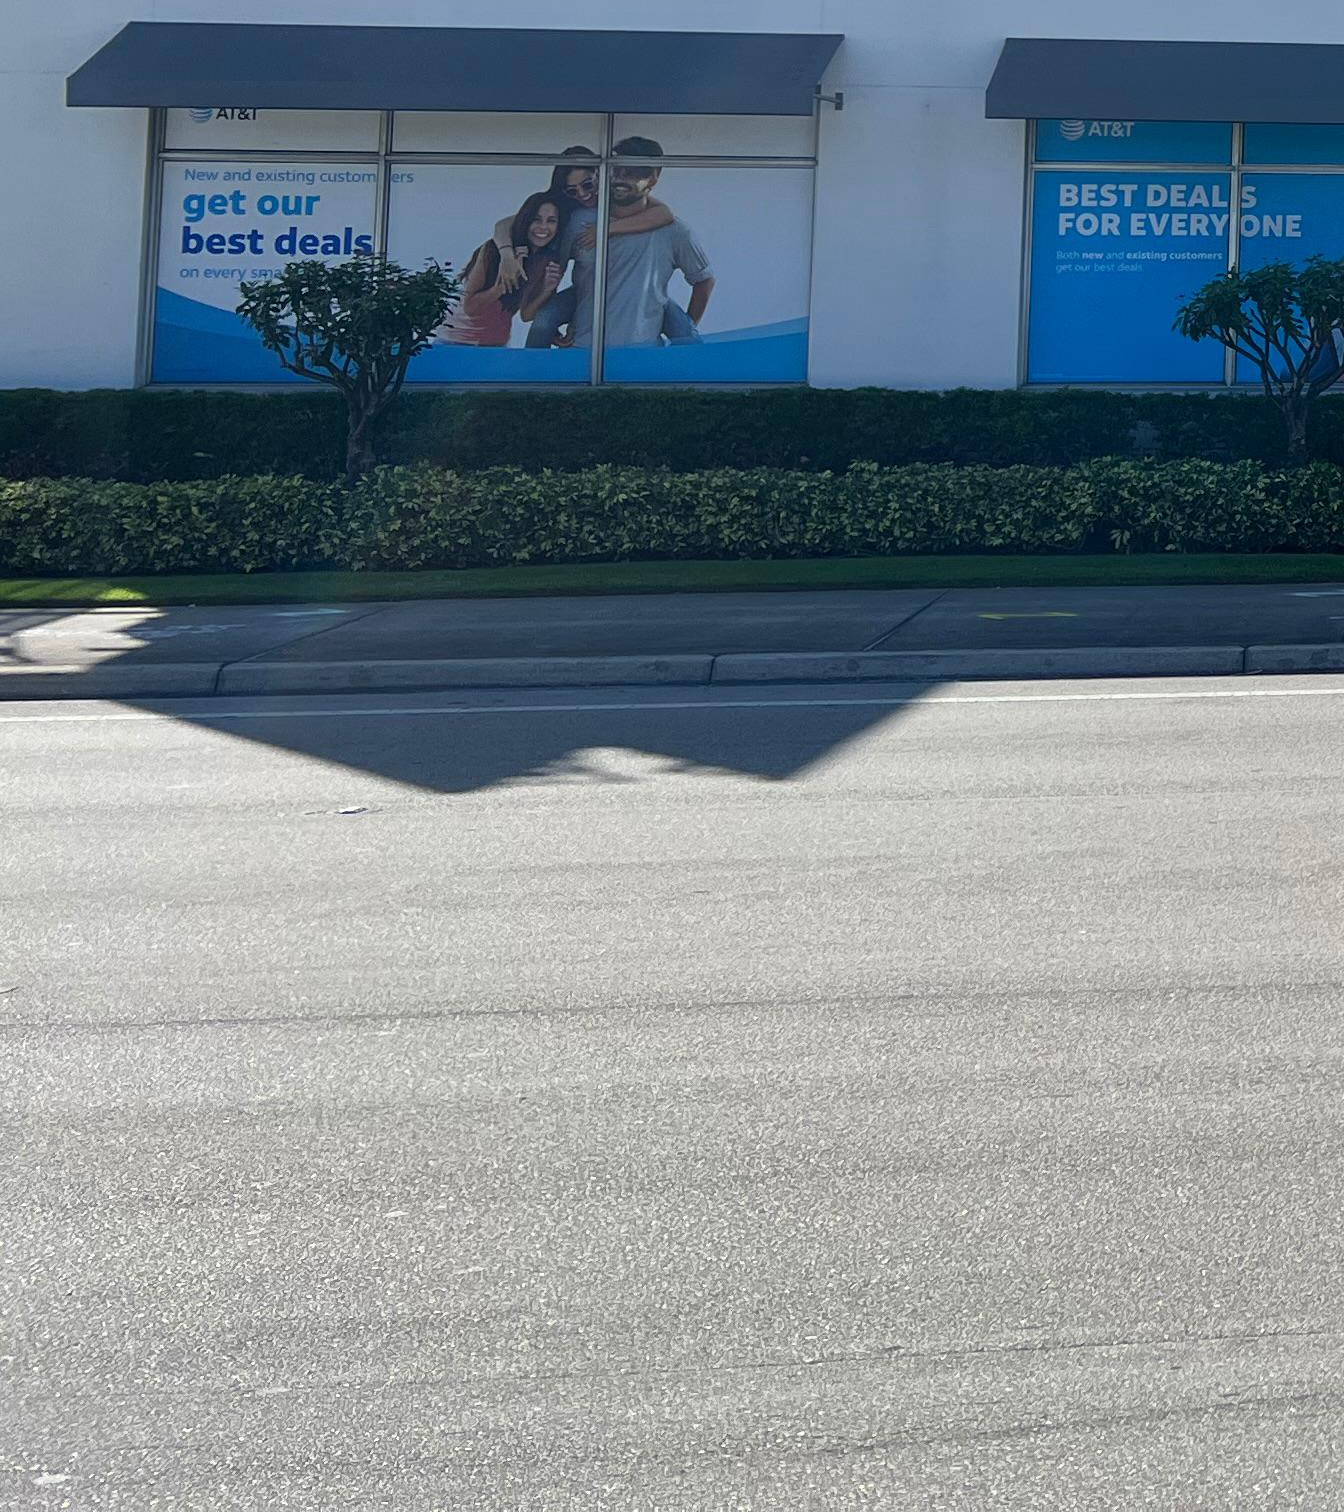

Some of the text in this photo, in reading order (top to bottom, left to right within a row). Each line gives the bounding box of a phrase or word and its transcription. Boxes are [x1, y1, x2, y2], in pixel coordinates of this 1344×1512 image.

[215, 107, 257, 121] AT&T
[1088, 121, 1135, 137] AT&T
[184, 168, 218, 181] New
[223, 169, 251, 181] and
[255, 169, 316, 185] existing
[1059, 184, 1257, 209] BEST DEALS
[183, 189, 321, 223] get our
[1058, 213, 1302, 237] FOR EVERYONE
[181, 226, 374, 256] best deals
[1056, 251, 1223, 262] Both new and existing customers
[180, 267, 199, 278] on
[204, 267, 246, 282] every
[1055, 263, 1073, 273] get
[1074, 264, 1091, 272] our
